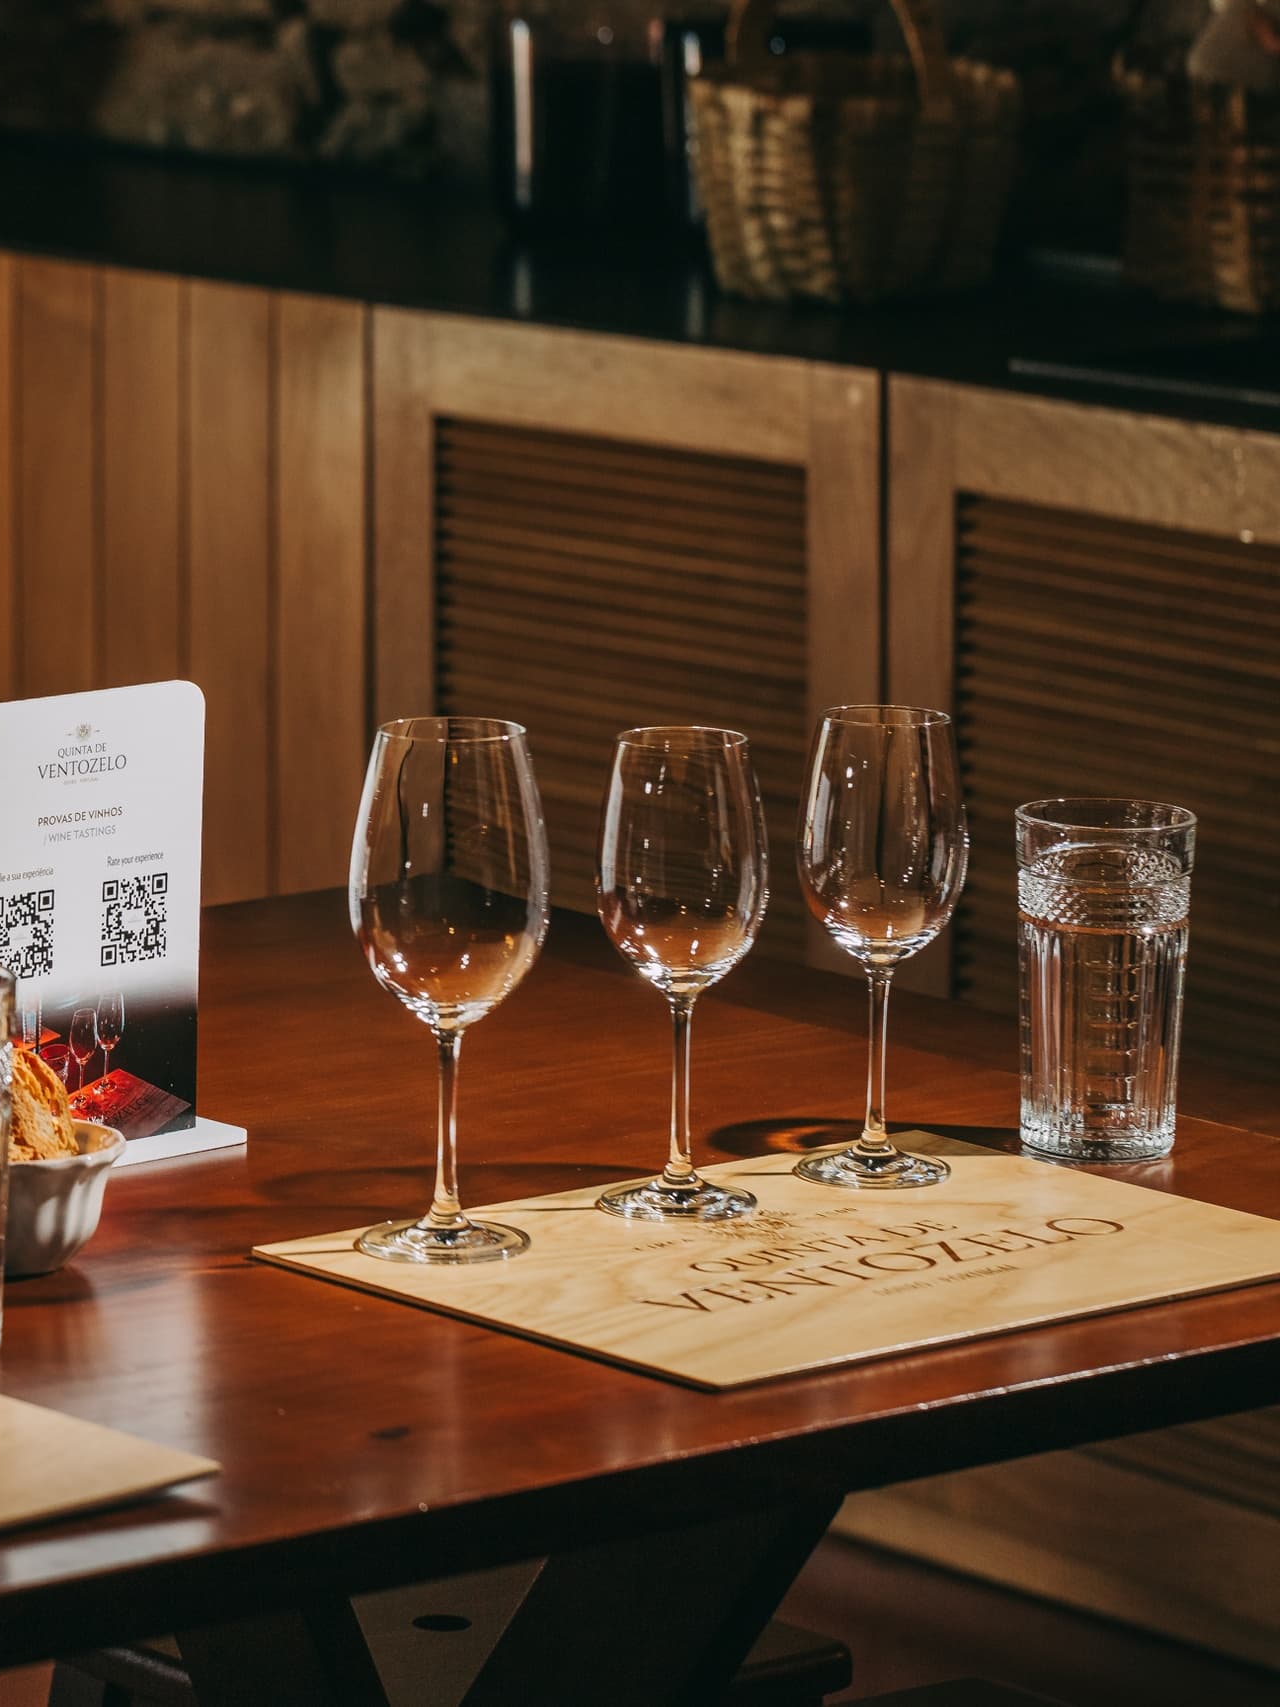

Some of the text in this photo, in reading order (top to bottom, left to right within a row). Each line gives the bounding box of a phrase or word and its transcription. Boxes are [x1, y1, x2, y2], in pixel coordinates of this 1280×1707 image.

[58, 743, 107, 758] QUINTA DE
[38, 754, 127, 779] VENTOZELO
[38, 806, 123, 827] PROVAS DE VINHOS
[48, 831, 72, 843] WINE
[73, 825, 116, 840] TASTINGS
[121, 856, 134, 867] your
[134, 852, 164, 864] experience
[688, 1219, 958, 1274] QUINTA DE
[640, 1217, 1125, 1312] VENTOZELO
